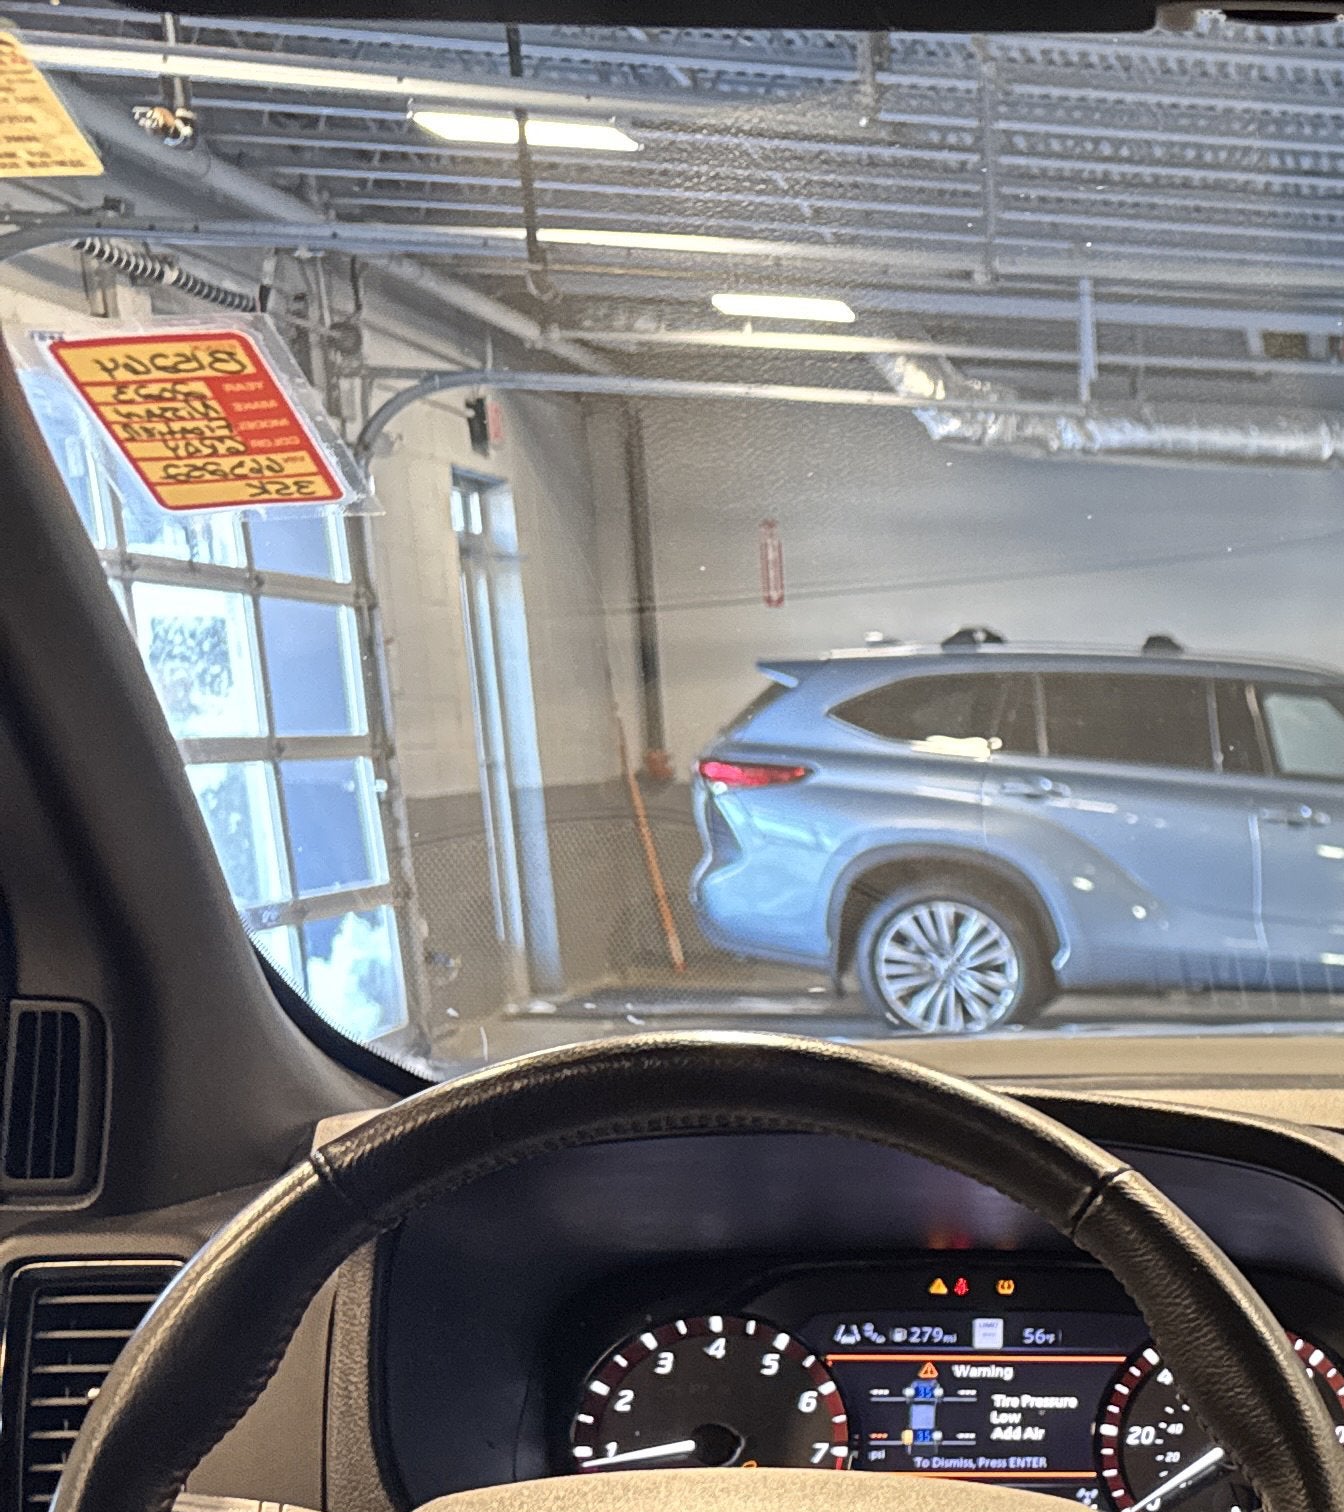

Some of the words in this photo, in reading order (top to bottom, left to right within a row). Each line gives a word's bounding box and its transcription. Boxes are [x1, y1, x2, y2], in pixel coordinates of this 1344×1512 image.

[704, 1337, 726, 1359] 4
[654, 1352, 675, 1375] 3
[760, 1353, 780, 1376] 5
[952, 1364, 1015, 1381] Warning
[614, 1389, 635, 1412] 2
[798, 1390, 819, 1413] 6
[990, 1393, 1019, 1409] Tire
[1020, 1394, 1079, 1409] Pressure
[990, 1410, 1022, 1424] Low
[990, 1426, 1021, 1440] Add
[1023, 1426, 1046, 1440] Air
[1126, 1425, 1155, 1446] 20
[1166, 1422, 1184, 1435] 40
[811, 1442, 830, 1464] 7
[913, 1456, 929, 1468] To
[979, 1456, 1008, 1468] Press
[1009, 1456, 1047, 1468] ENTER
[1164, 1451, 1181, 1464] 20
